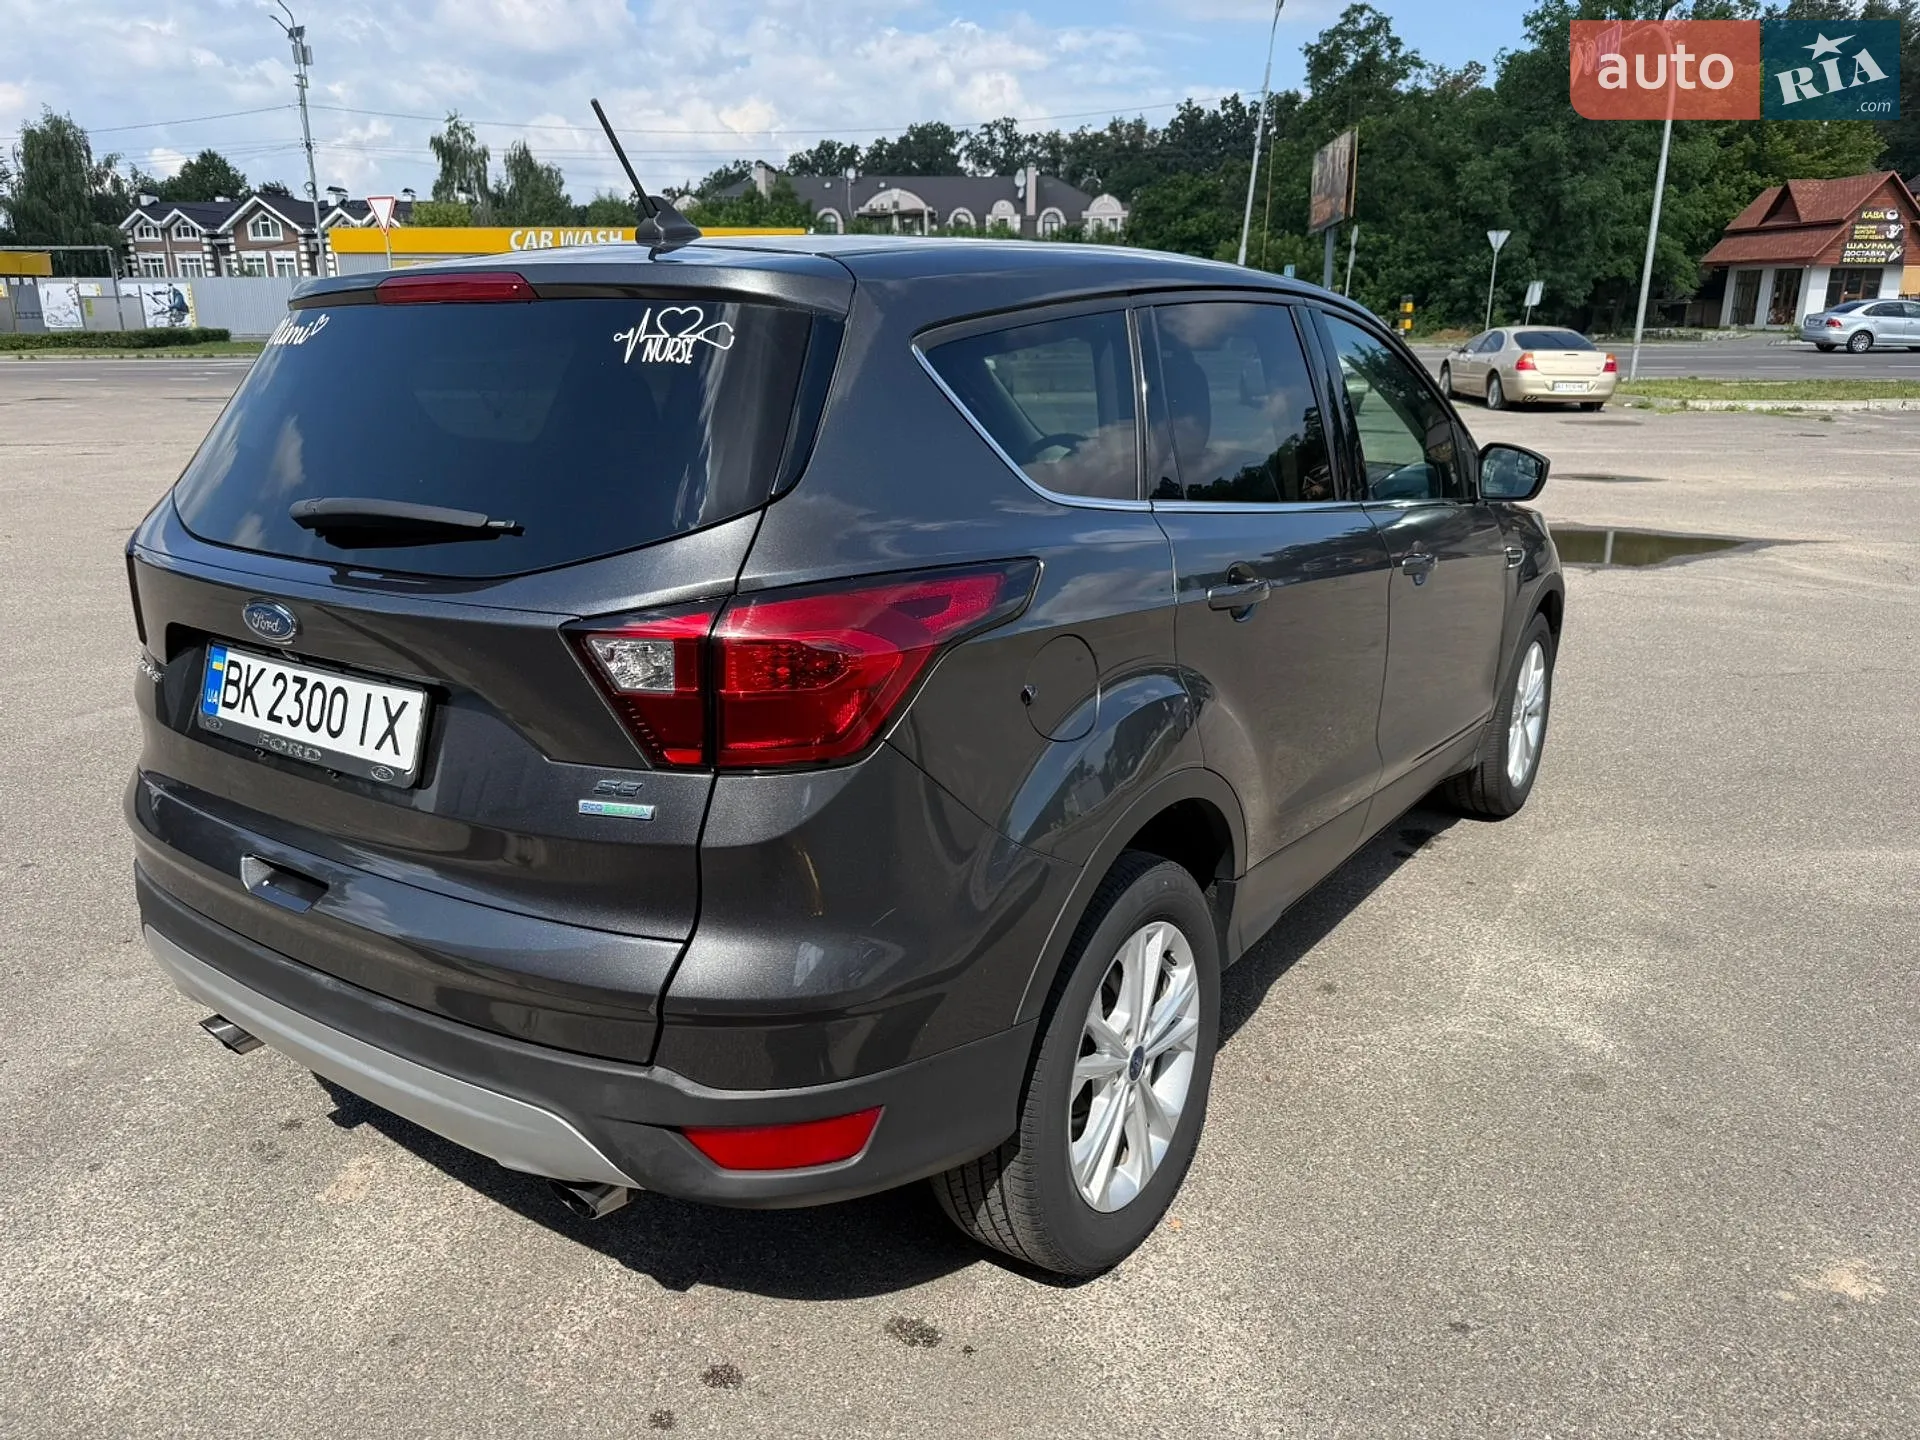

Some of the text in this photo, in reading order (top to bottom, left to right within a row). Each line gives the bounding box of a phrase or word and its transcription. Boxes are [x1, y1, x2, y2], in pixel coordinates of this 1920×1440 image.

[1862, 210, 1885, 219] КАВА
[509, 230, 622, 250] CAR WASH
[1846, 242, 1895, 250] ШАУРМА
[641, 337, 696, 364] NURSE
[252, 608, 281, 633] Ford
[221, 660, 409, 756] BK 2300 IX
